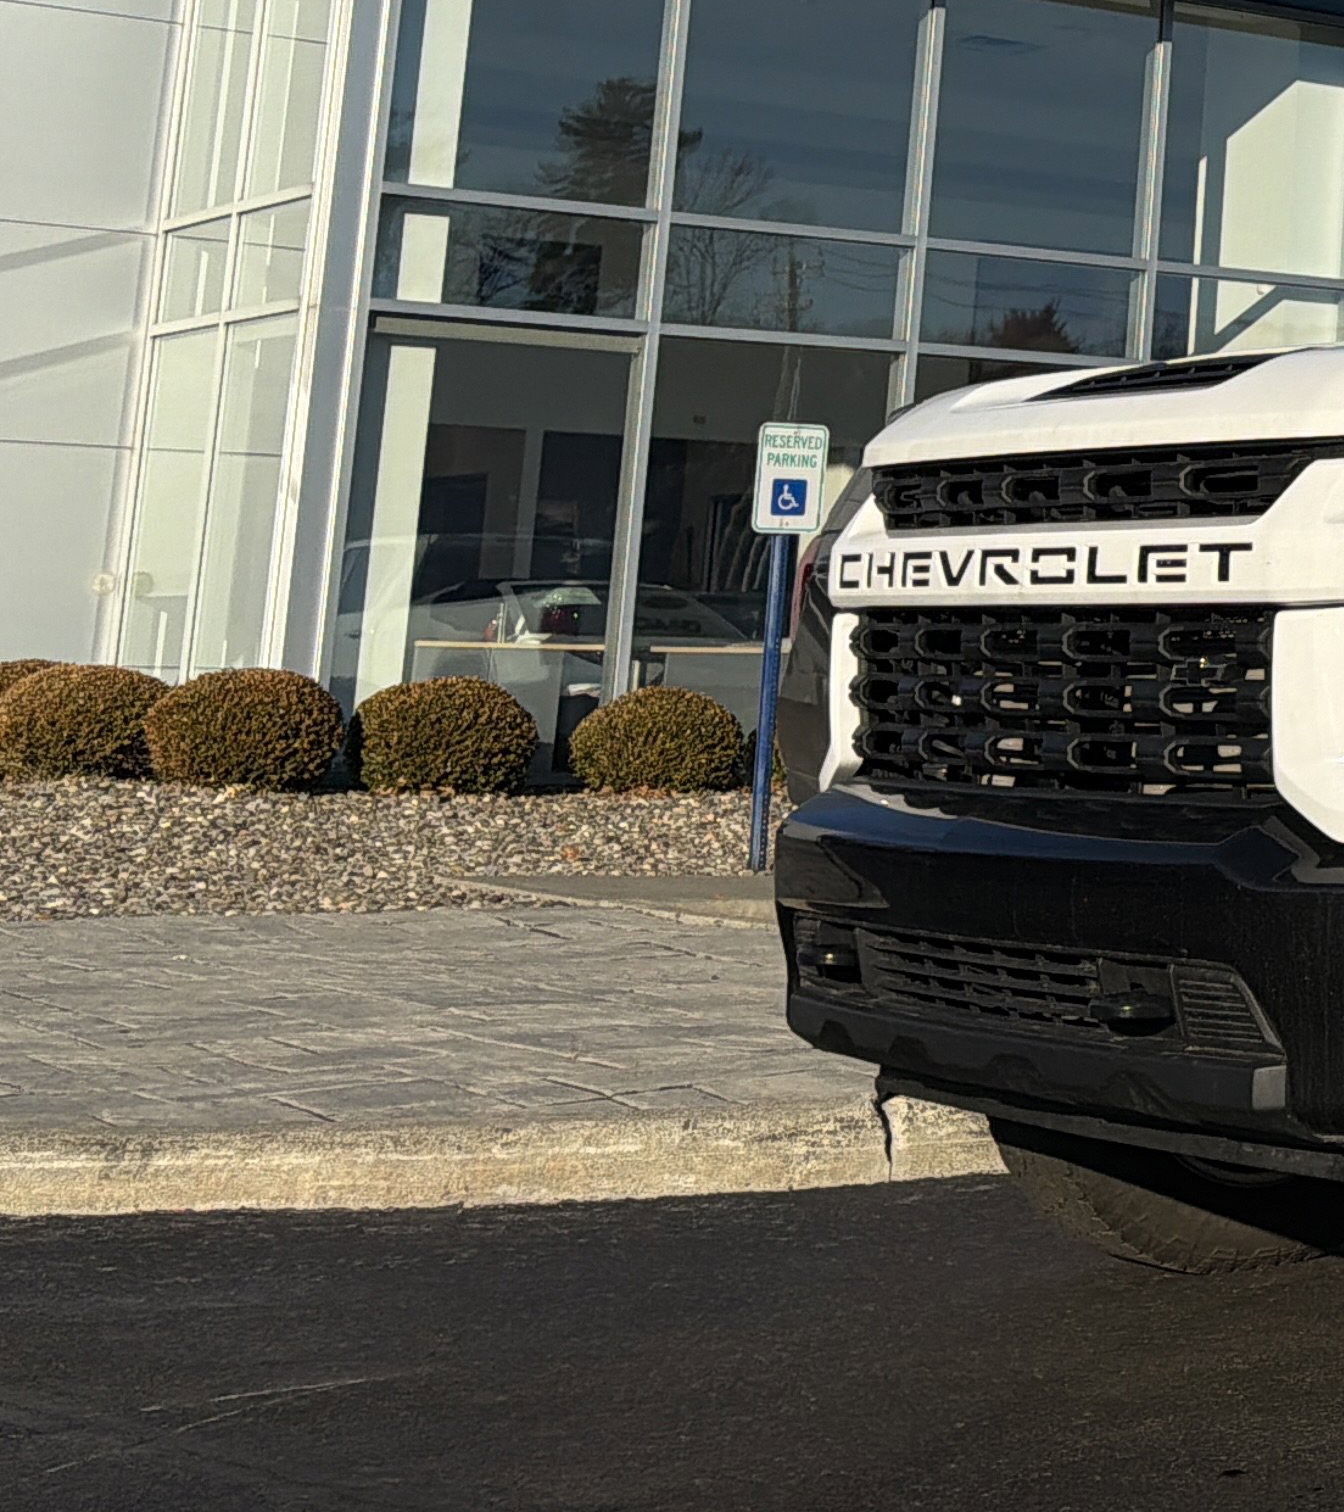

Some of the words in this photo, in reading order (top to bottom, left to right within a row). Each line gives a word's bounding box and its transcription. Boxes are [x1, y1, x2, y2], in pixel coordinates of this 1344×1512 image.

[764, 433, 823, 450] RESERVED
[766, 452, 818, 468] PARKING
[839, 541, 1254, 589] CHEVROLET
